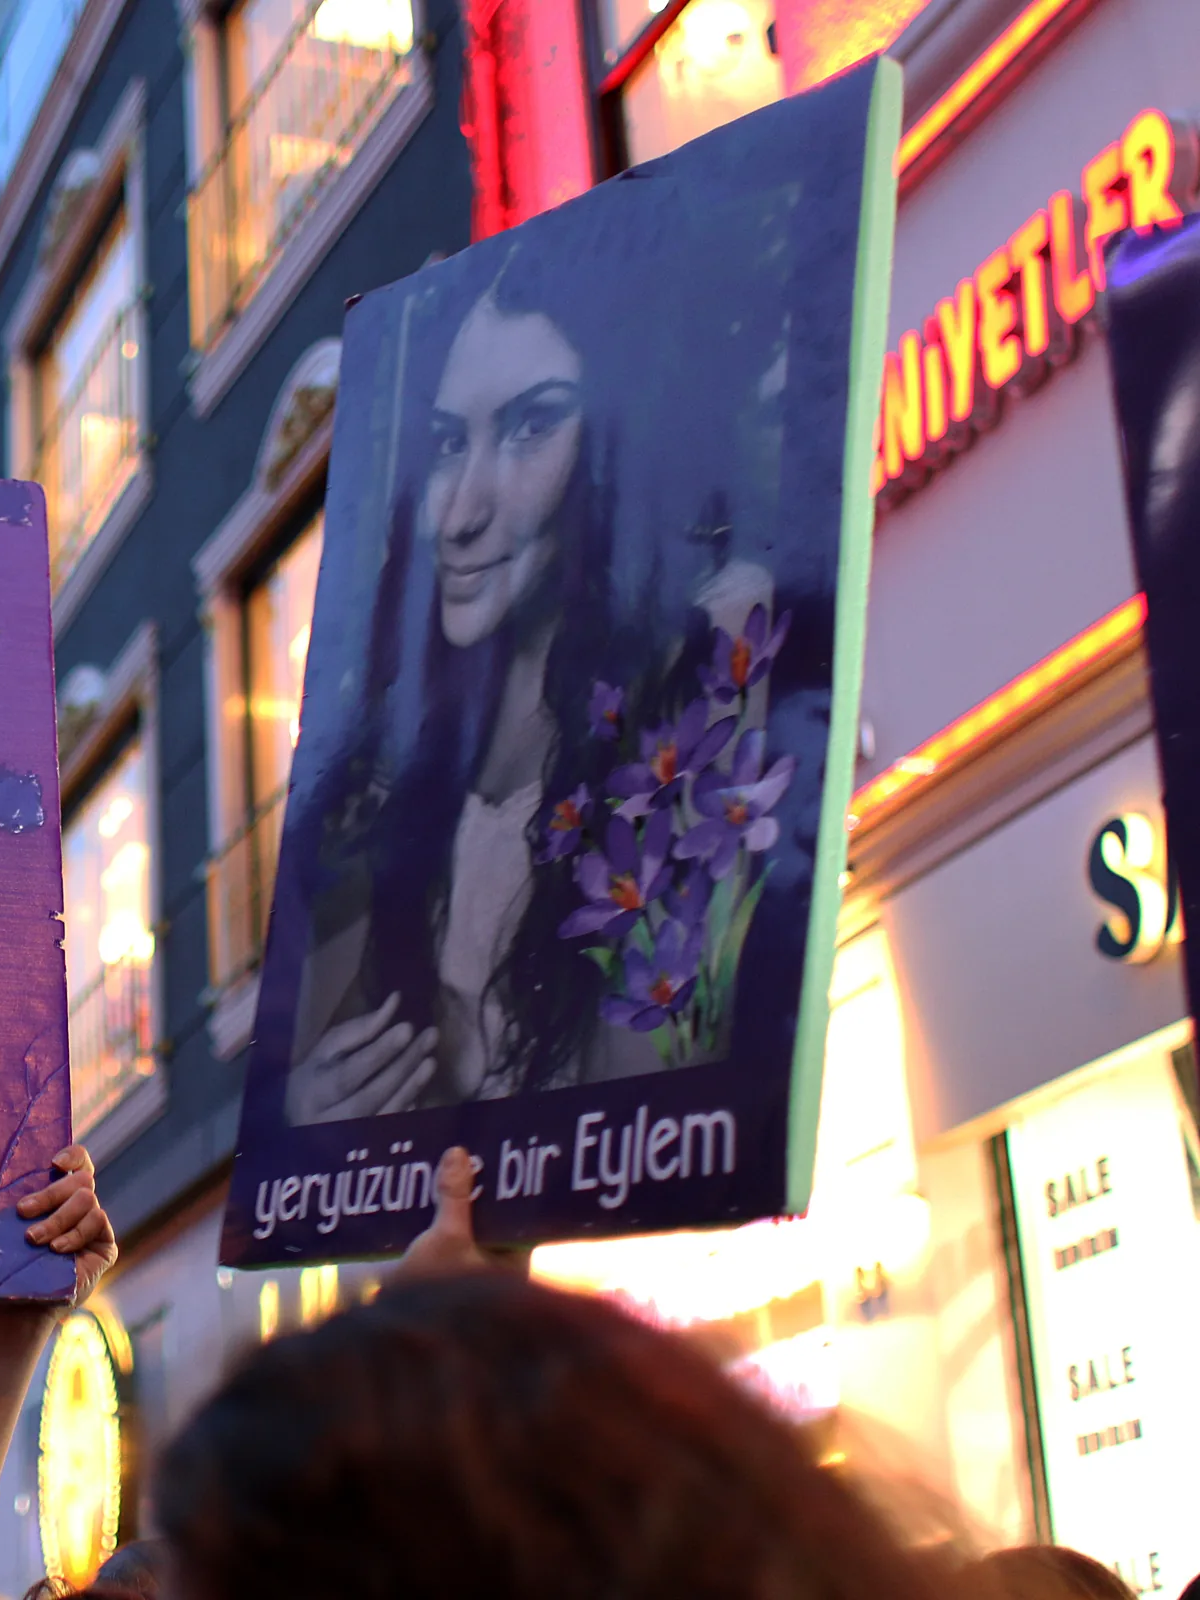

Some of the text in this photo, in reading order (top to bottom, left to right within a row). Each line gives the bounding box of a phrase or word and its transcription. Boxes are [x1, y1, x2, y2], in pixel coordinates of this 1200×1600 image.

[496, 1136, 561, 1201] bir
[571, 1105, 737, 1209] Eylem
[1045, 1156, 1112, 1218] SALE
[1068, 1345, 1135, 1401] SALE
